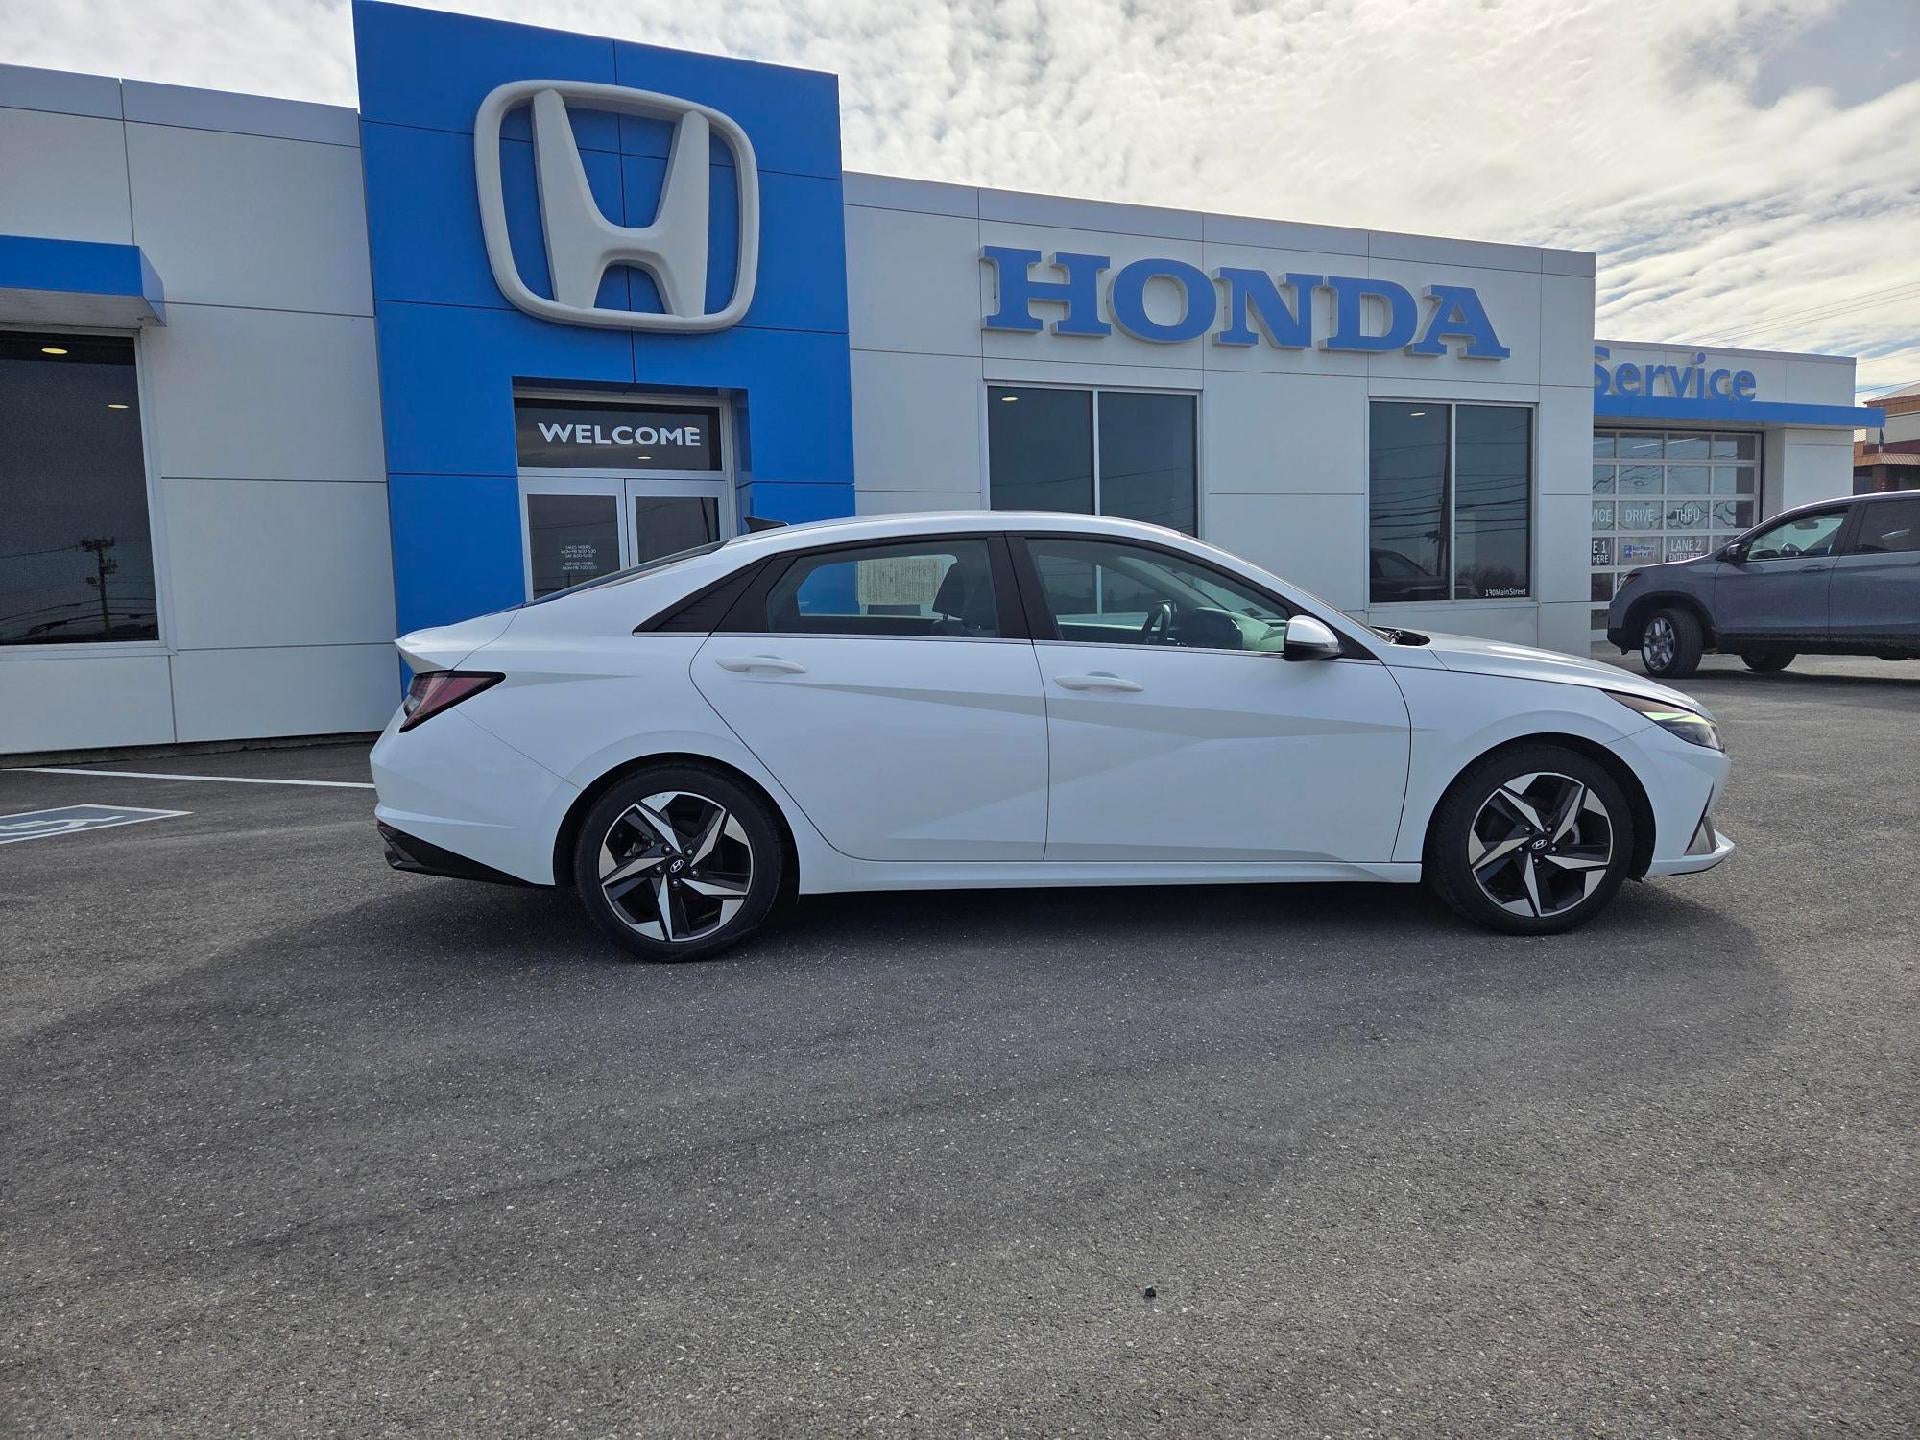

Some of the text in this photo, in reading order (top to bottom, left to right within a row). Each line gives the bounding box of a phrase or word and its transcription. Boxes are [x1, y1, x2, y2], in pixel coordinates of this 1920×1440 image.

[979, 245, 1511, 361] HONDA
[538, 422, 702, 446] WELCOME
[1625, 509, 1654, 521] DRIVE
[1670, 539, 1694, 552] LANE
[1695, 539, 1702, 552] 2
[1668, 552, 1687, 561] ENTER
